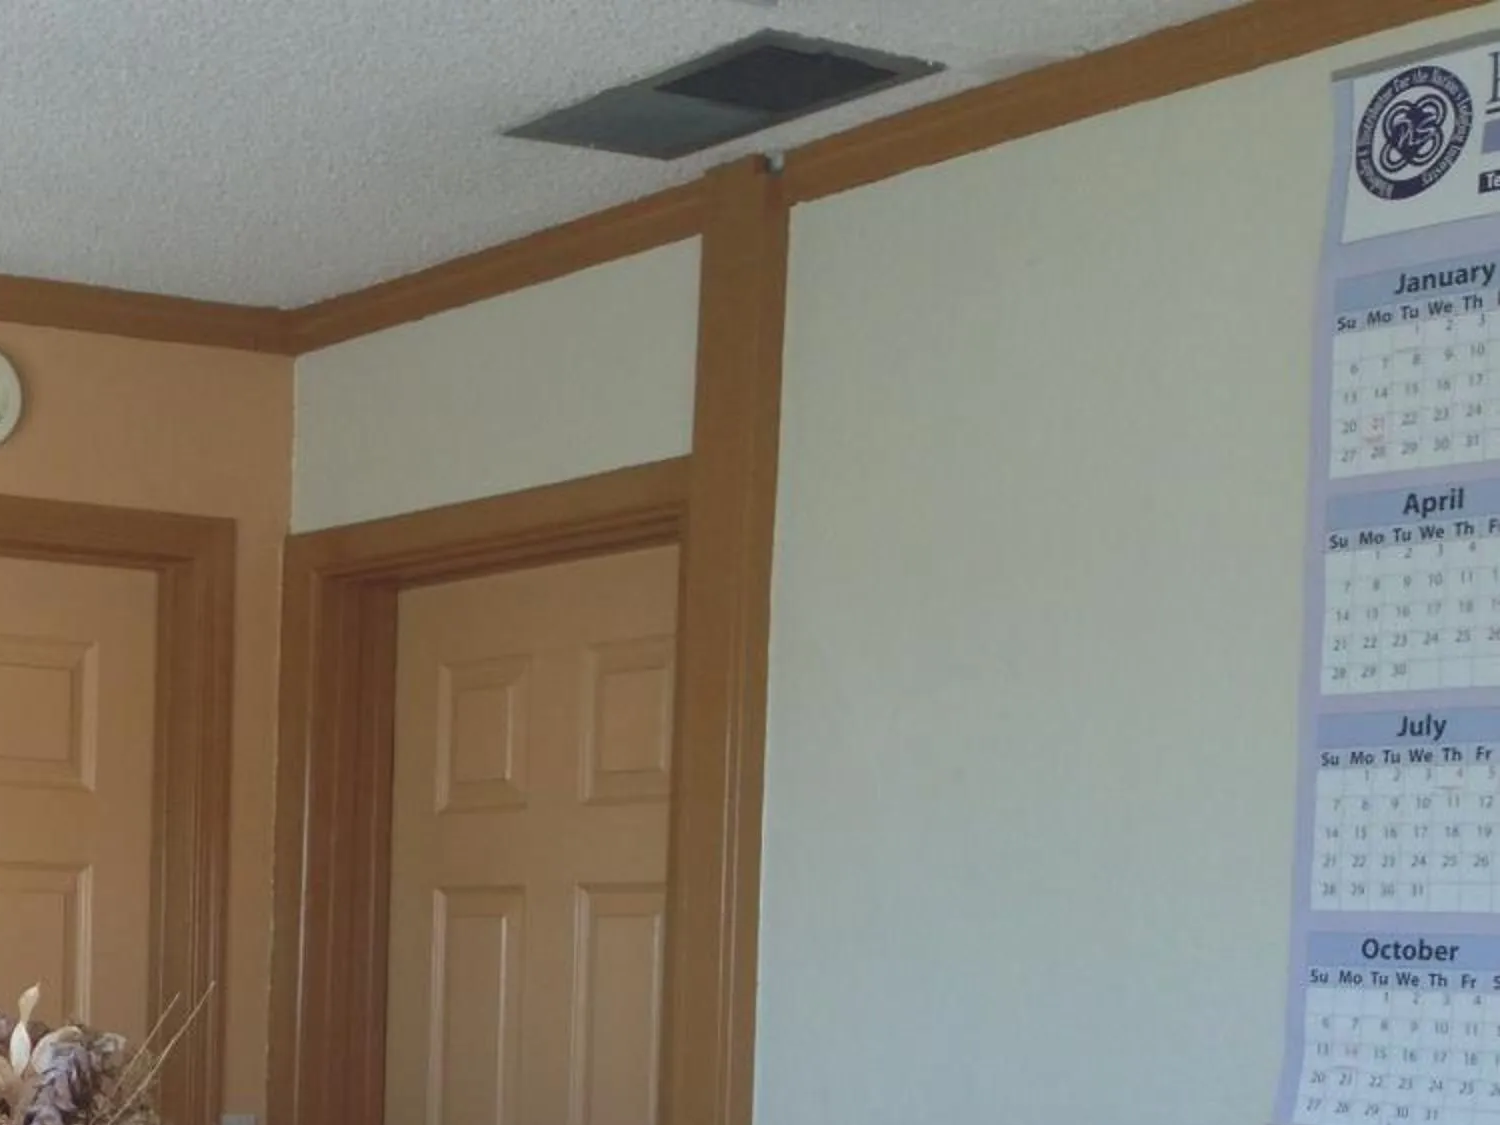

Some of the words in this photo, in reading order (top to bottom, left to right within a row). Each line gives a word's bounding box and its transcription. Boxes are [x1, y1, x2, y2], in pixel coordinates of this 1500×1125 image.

[1394, 263, 1496, 295] January
[1337, 317, 1356, 331] Su
[1367, 310, 1392, 328] Mo
[1401, 305, 1419, 320] Tu
[1428, 301, 1452, 316] We
[1462, 295, 1483, 311] Th
[1403, 487, 1464, 518] April
[1329, 535, 1348, 550] Su
[1359, 532, 1384, 545] Mo
[1392, 528, 1411, 543] Tu
[1418, 525, 1444, 540] We
[1454, 522, 1474, 536] Th
[1396, 713, 1447, 740] July
[1322, 752, 1339, 766] Su
[1350, 752, 1374, 764] Mo
[1382, 750, 1400, 764] Tu
[1408, 749, 1433, 763] We
[1441, 748, 1462, 761] Th
[1476, 746, 1492, 761] Fr
[1361, 938, 1459, 960] October
[1310, 969, 1328, 983] Su
[1339, 970, 1362, 984] Mo
[1371, 972, 1388, 985] Tu
[1396, 972, 1419, 986] We
[1428, 973, 1447, 987] Th
[1461, 974, 1476, 988] Fr
